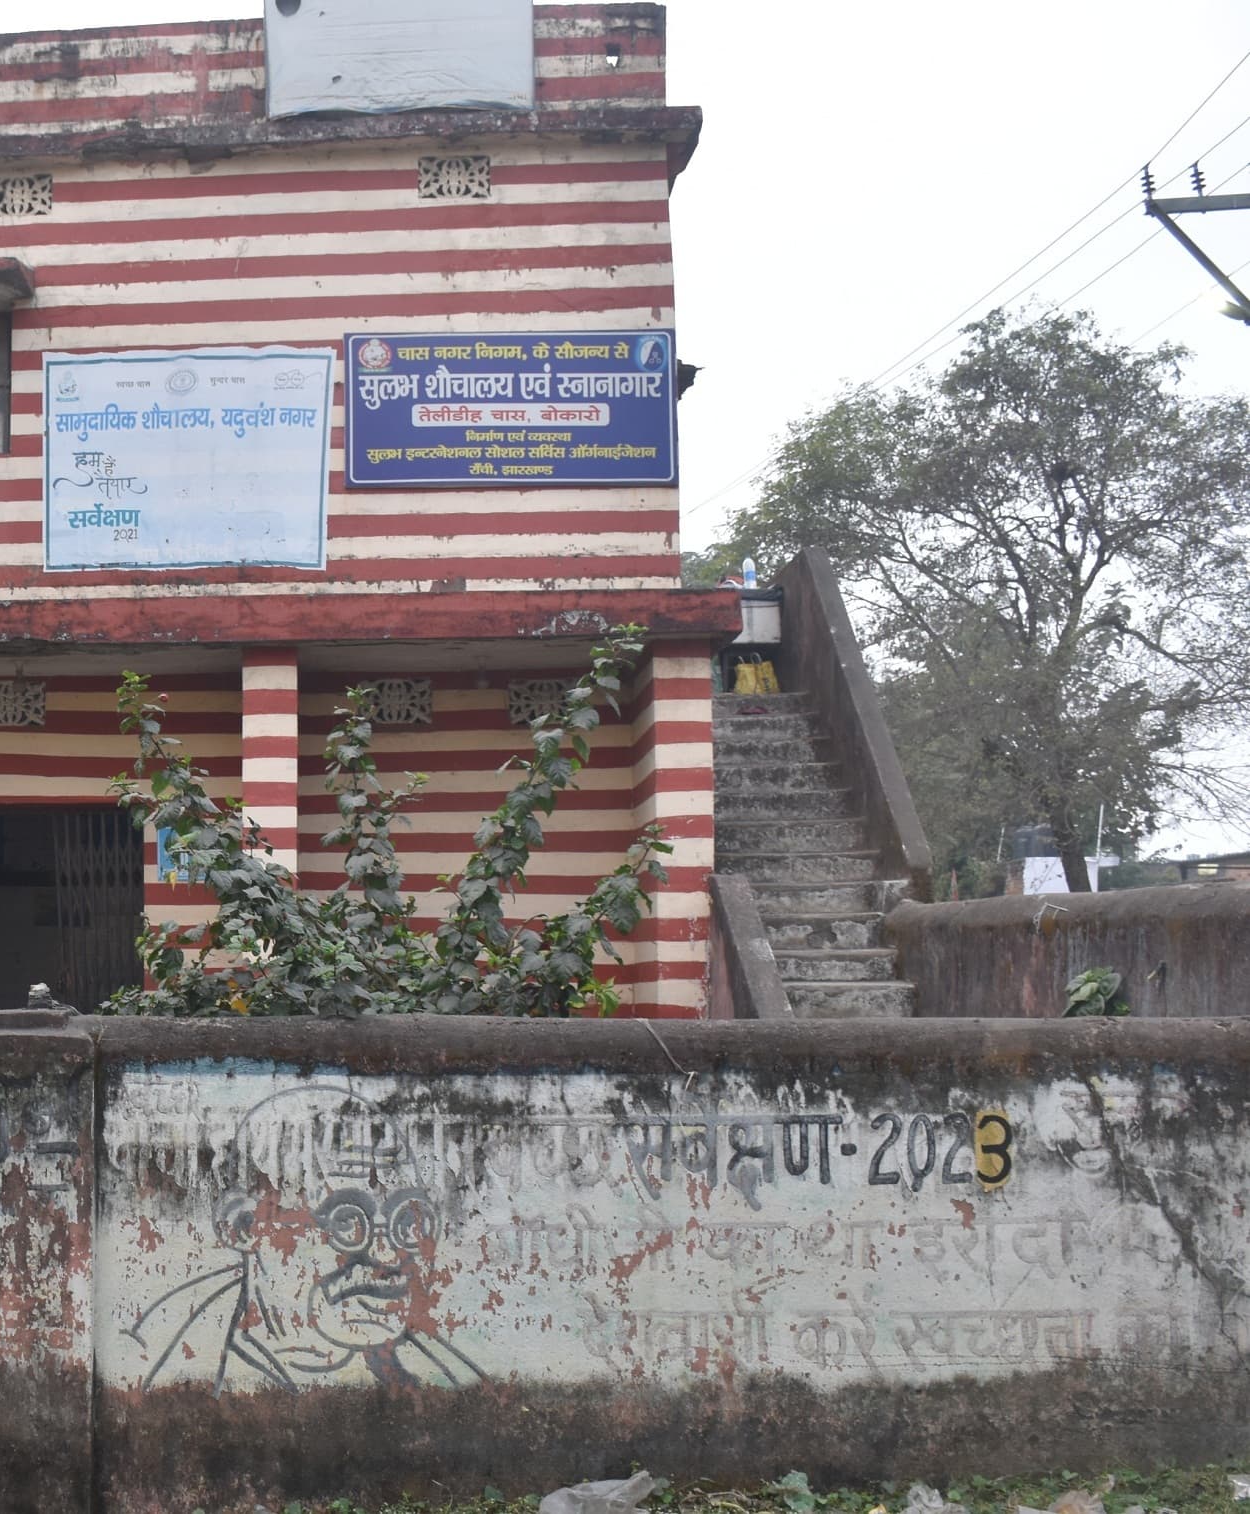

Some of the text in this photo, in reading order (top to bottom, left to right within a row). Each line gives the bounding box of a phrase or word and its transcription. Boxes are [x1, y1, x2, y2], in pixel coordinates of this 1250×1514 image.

[398, 341, 629, 361] चास नगर निगम, के सौजन्य से
[358, 363, 662, 410] सुलभ शौचालय एवं स्नानागार
[55, 402, 317, 441] सामुदायिक शौचालय, यदुवंश नगर
[419, 404, 601, 423] तेलीडीह चास, बोकारो
[465, 430, 504, 442] निर्माण
[507, 430, 526, 442] एवं
[366, 448, 402, 464] सुलभ
[484, 444, 527, 458] सोशल
[528, 444, 566, 458] सर्विस
[501, 465, 554, 476] झारखण्ड
[93, 468, 148, 500] तैयार
[67, 502, 141, 529] सर्वेक्षण
[113, 528, 138, 543] 2021
